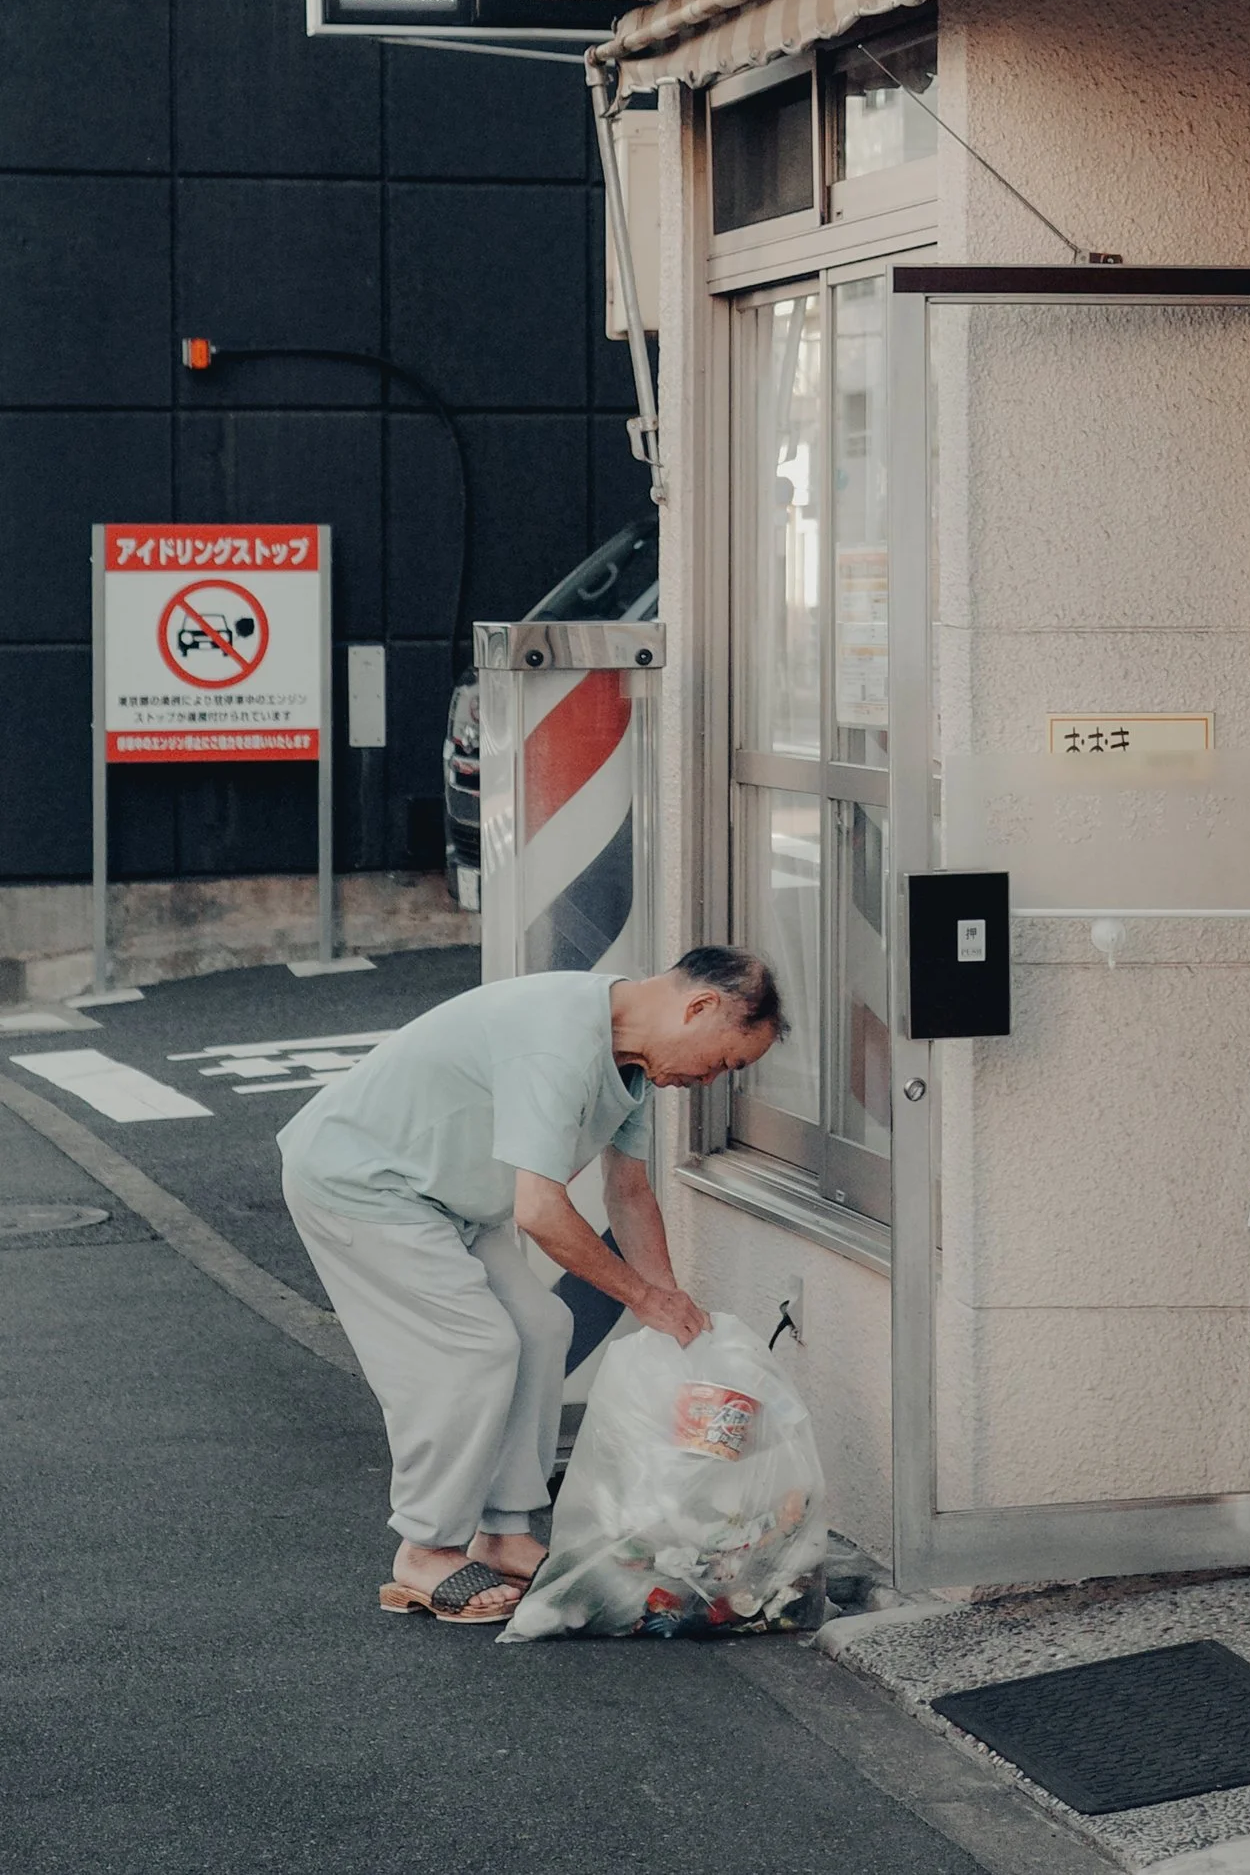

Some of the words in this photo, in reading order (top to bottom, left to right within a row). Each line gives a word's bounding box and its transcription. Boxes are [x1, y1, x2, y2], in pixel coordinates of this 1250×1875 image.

[116, 538, 310, 566] アイドリングストップ
